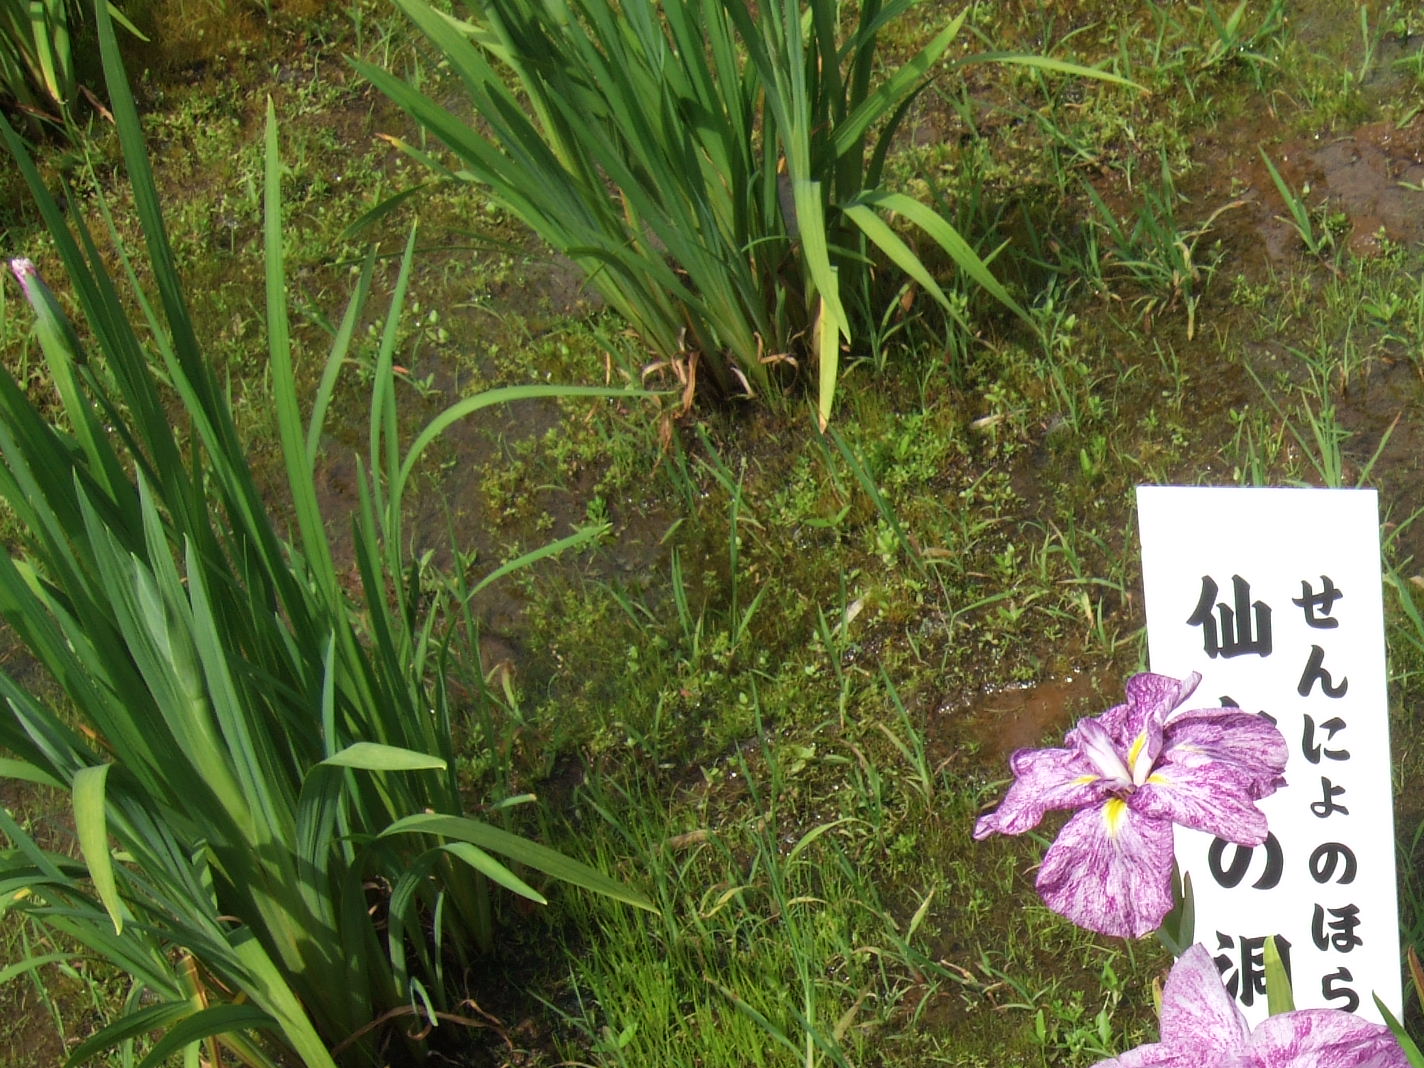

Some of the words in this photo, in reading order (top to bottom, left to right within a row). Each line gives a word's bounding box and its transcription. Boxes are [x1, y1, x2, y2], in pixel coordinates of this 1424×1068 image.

[1186, 574, 1292, 1007] 仙の洞
[1291, 574, 1363, 1012] せんにょのほら
